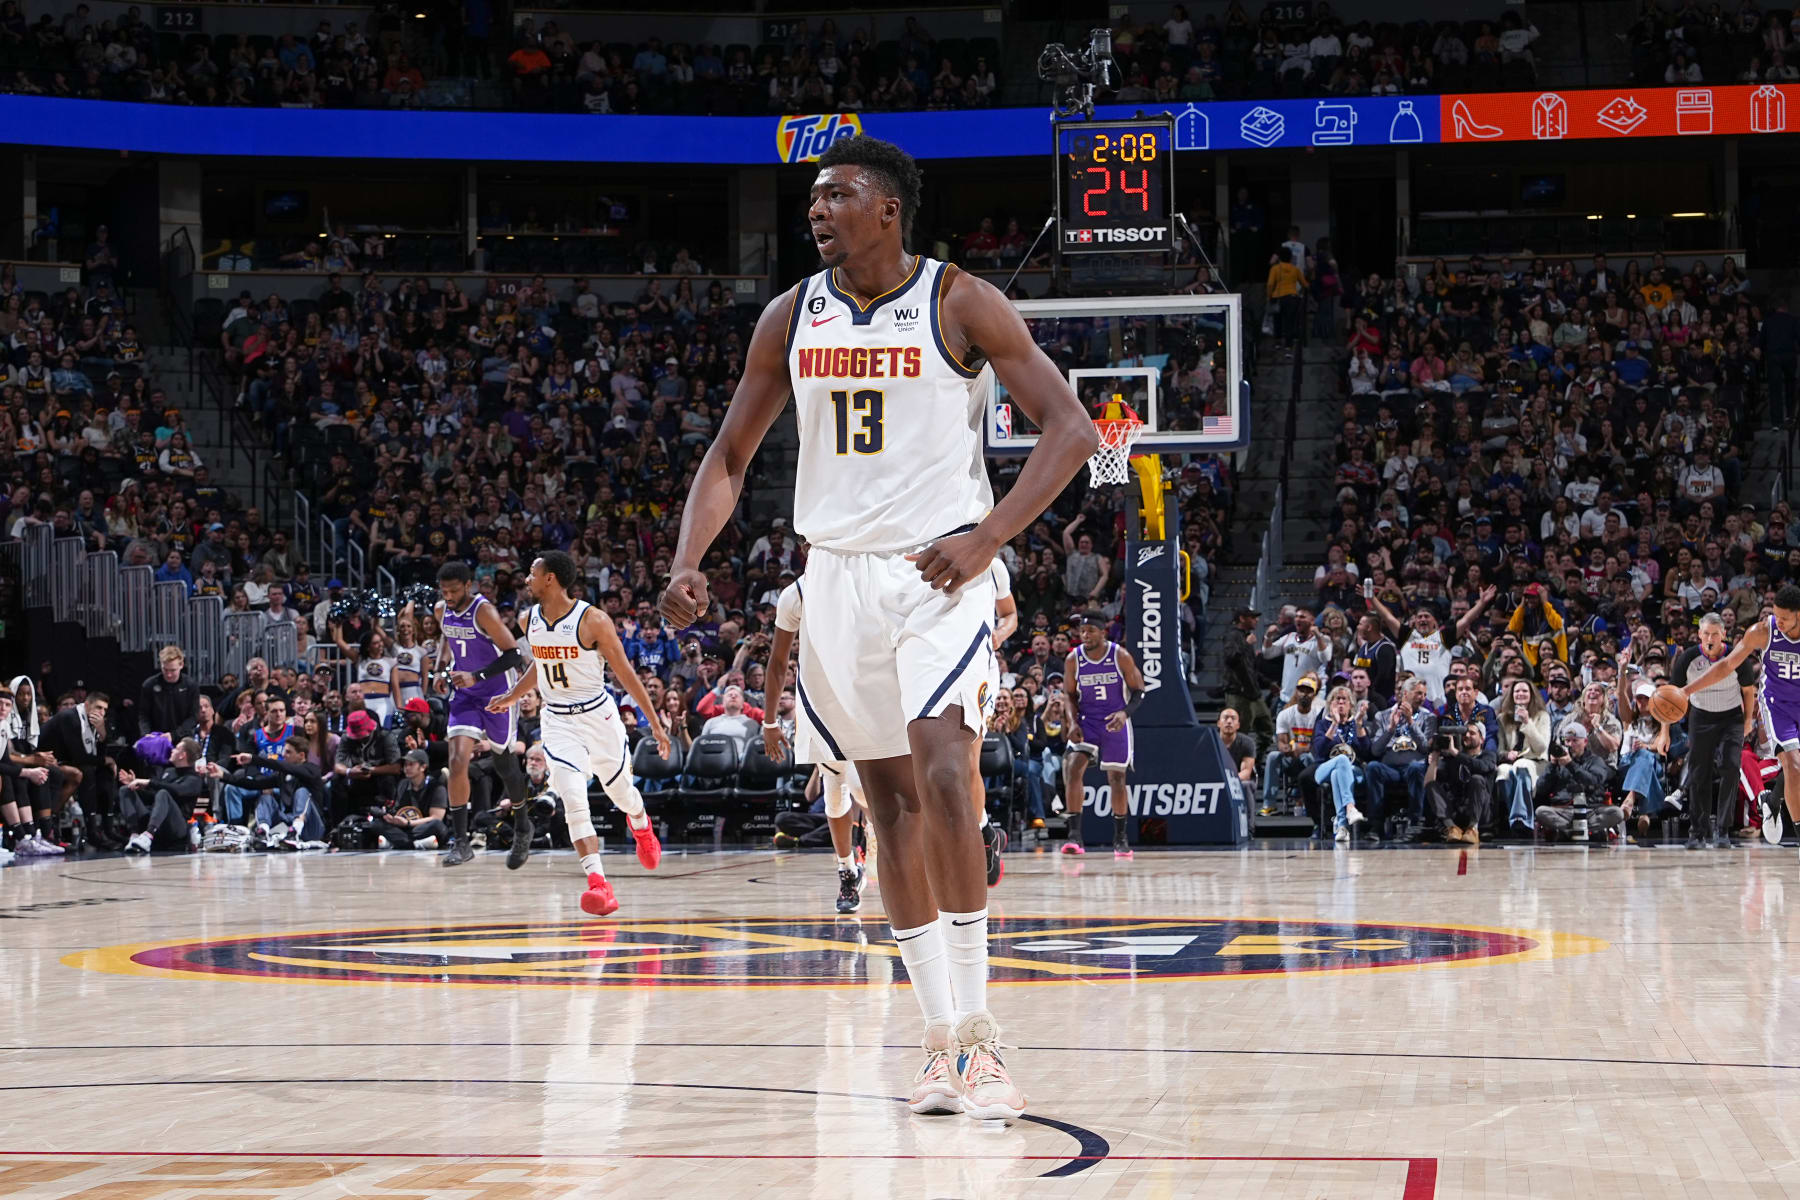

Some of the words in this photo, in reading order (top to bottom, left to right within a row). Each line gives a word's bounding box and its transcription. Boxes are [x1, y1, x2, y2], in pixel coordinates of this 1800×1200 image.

[164, 12, 194, 26] 212
[1275, 6, 1305, 20] 216
[1093, 134, 1156, 163] 2:08
[1083, 167, 1148, 217] 24
[1093, 227, 1167, 242] TISSOT
[811, 297, 824, 311] 6
[894, 308, 919, 320] WU
[799, 347, 921, 379] NUGGETS
[831, 389, 884, 456] 13
[1137, 545, 1165, 564] Ball
[444, 625, 477, 640] SAC
[456, 639, 467, 658] 7
[1137, 591, 1162, 693] verizon
[531, 645, 580, 661] NUGGETS
[1418, 651, 1430, 664] 15
[1770, 650, 1800, 664] SA
[543, 662, 569, 689] 14
[1778, 662, 1800, 680] 35
[1080, 672, 1118, 687] SAC
[1094, 685, 1107, 700] 3
[1083, 782, 1225, 817] PONTSBET
